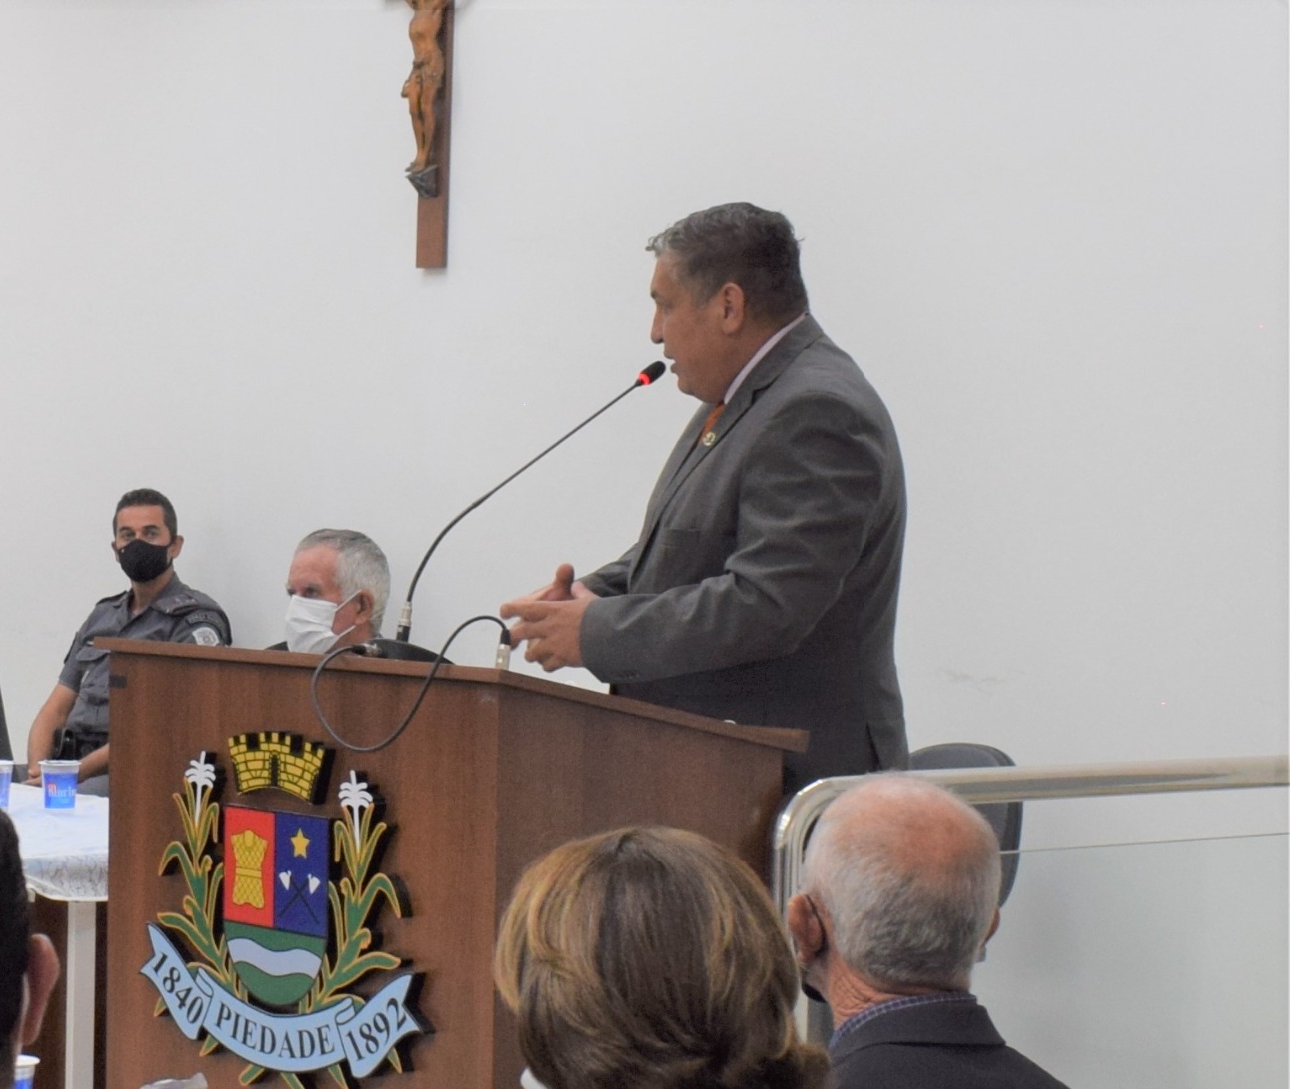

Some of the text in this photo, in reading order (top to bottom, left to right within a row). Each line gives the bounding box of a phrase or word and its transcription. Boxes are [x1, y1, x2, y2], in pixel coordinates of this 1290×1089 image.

[152, 951, 407, 1061] 1840 PIEDADE 1892
